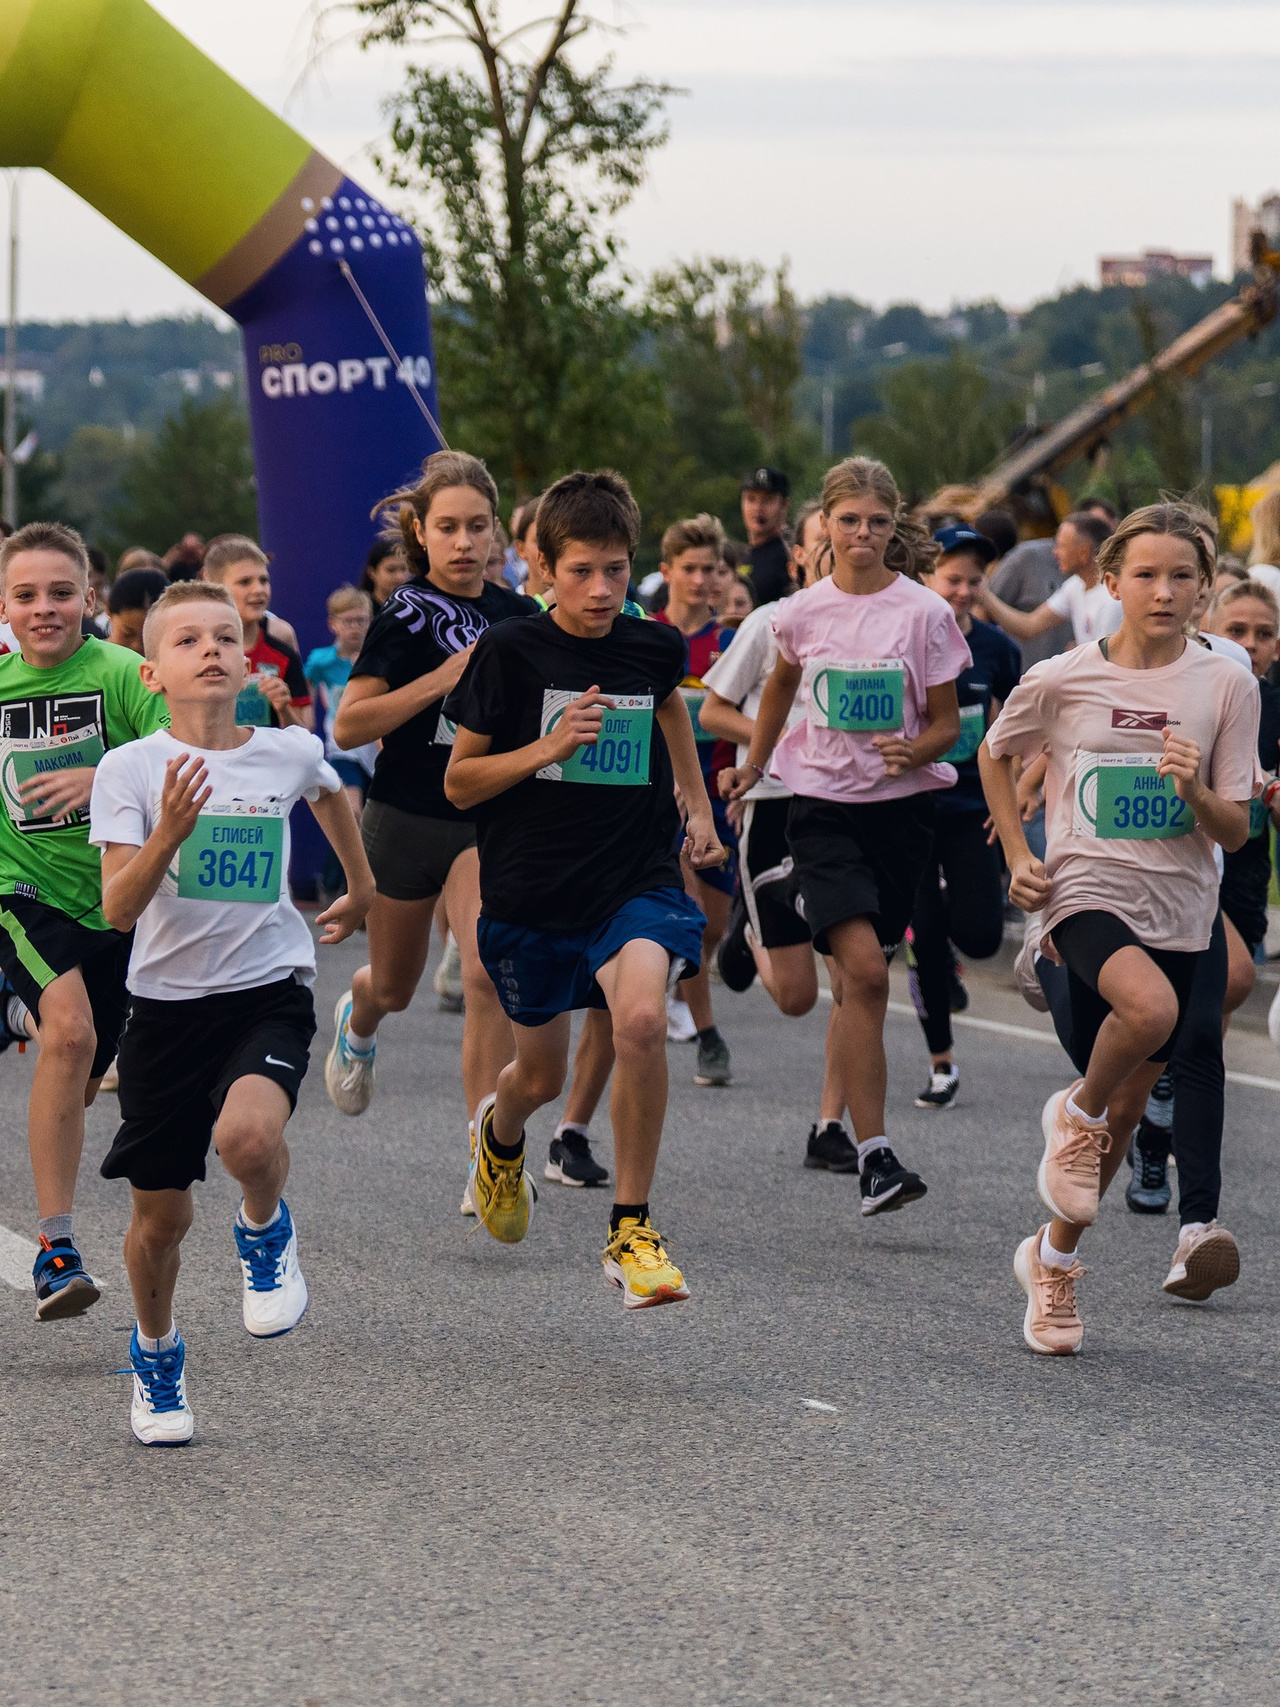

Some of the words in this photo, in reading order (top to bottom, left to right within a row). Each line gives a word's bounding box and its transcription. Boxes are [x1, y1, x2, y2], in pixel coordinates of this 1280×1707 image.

[261, 356, 391, 399] СПОРТ
[839, 693, 894, 722] 2400
[605, 718, 632, 734] ОЛЕГ
[34, 751, 84, 773] МАКСИМ
[580, 738, 642, 774] 4091
[1133, 776, 1165, 790] АННА
[1113, 795, 1186, 828] 3892
[212, 826, 263, 844] ЕЛИСЕЙ
[198, 849, 274, 889] 3647
